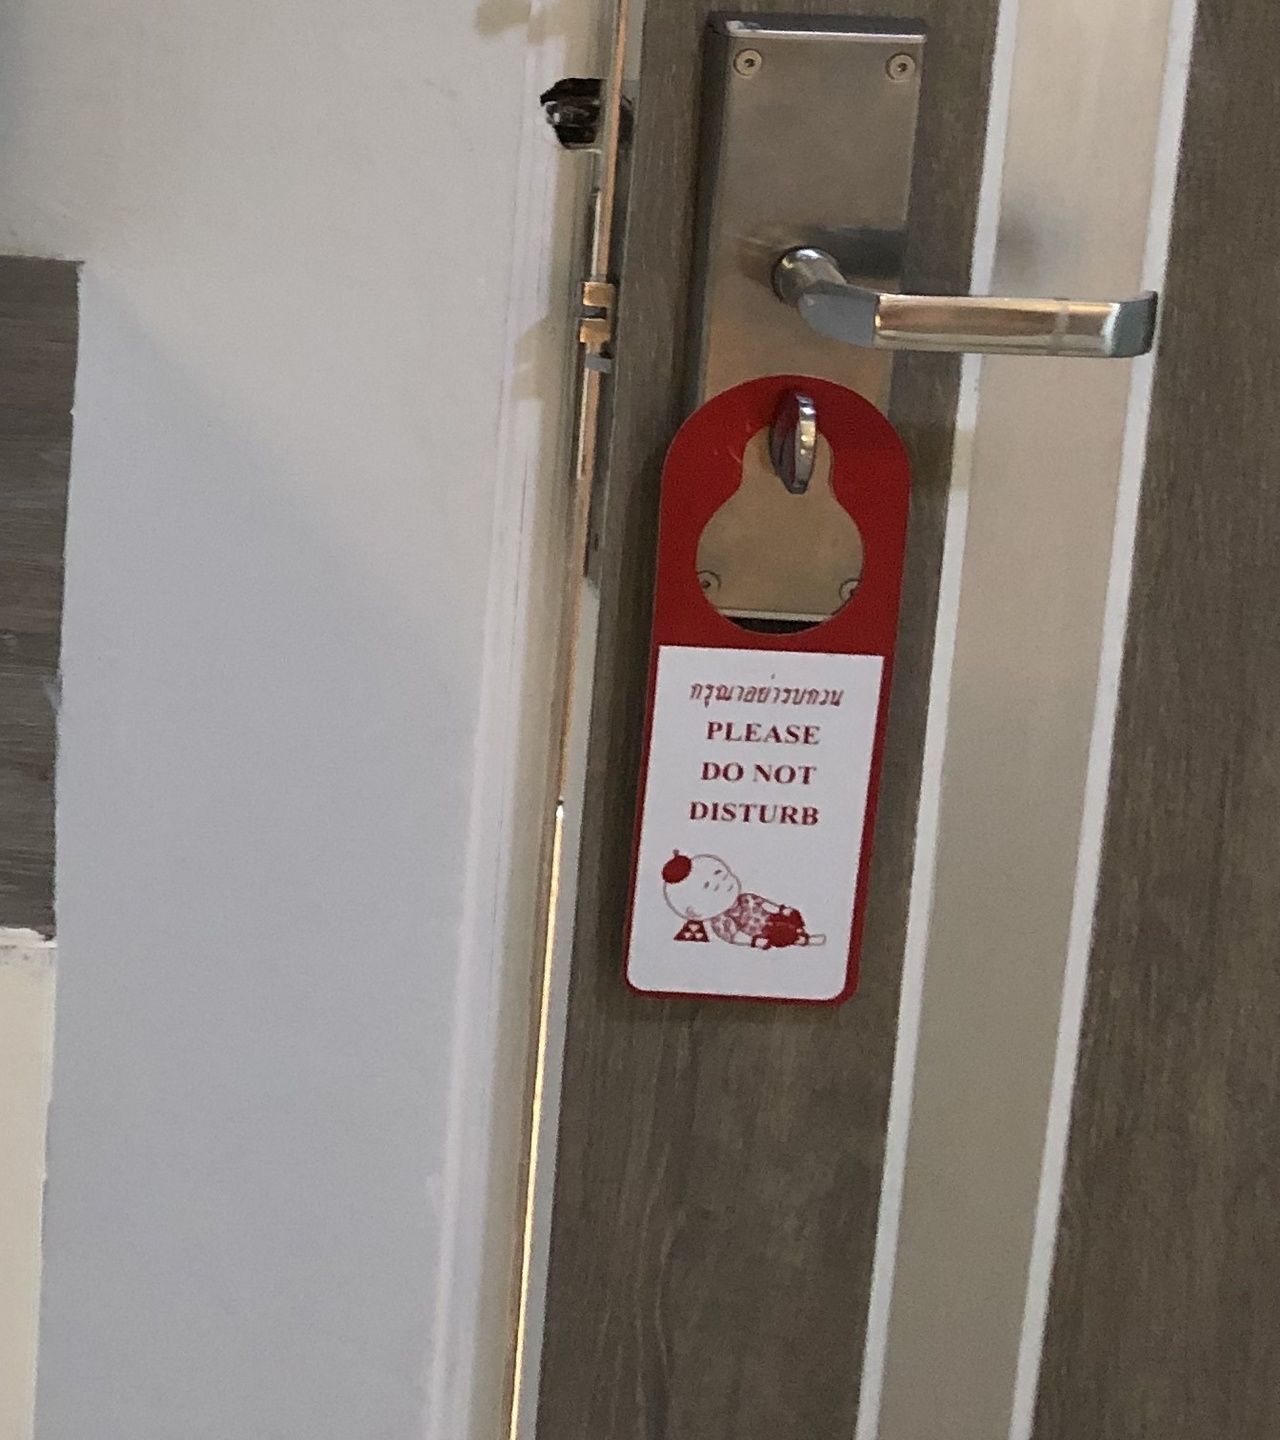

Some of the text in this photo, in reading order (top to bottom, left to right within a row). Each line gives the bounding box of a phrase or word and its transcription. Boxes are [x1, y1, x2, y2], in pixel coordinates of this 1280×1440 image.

[689, 673, 844, 709] กรุณาอย่ารบกวน
[705, 720, 821, 746] PLEASE
[700, 761, 817, 786] DO NOT
[688, 800, 820, 827] DISTURB
